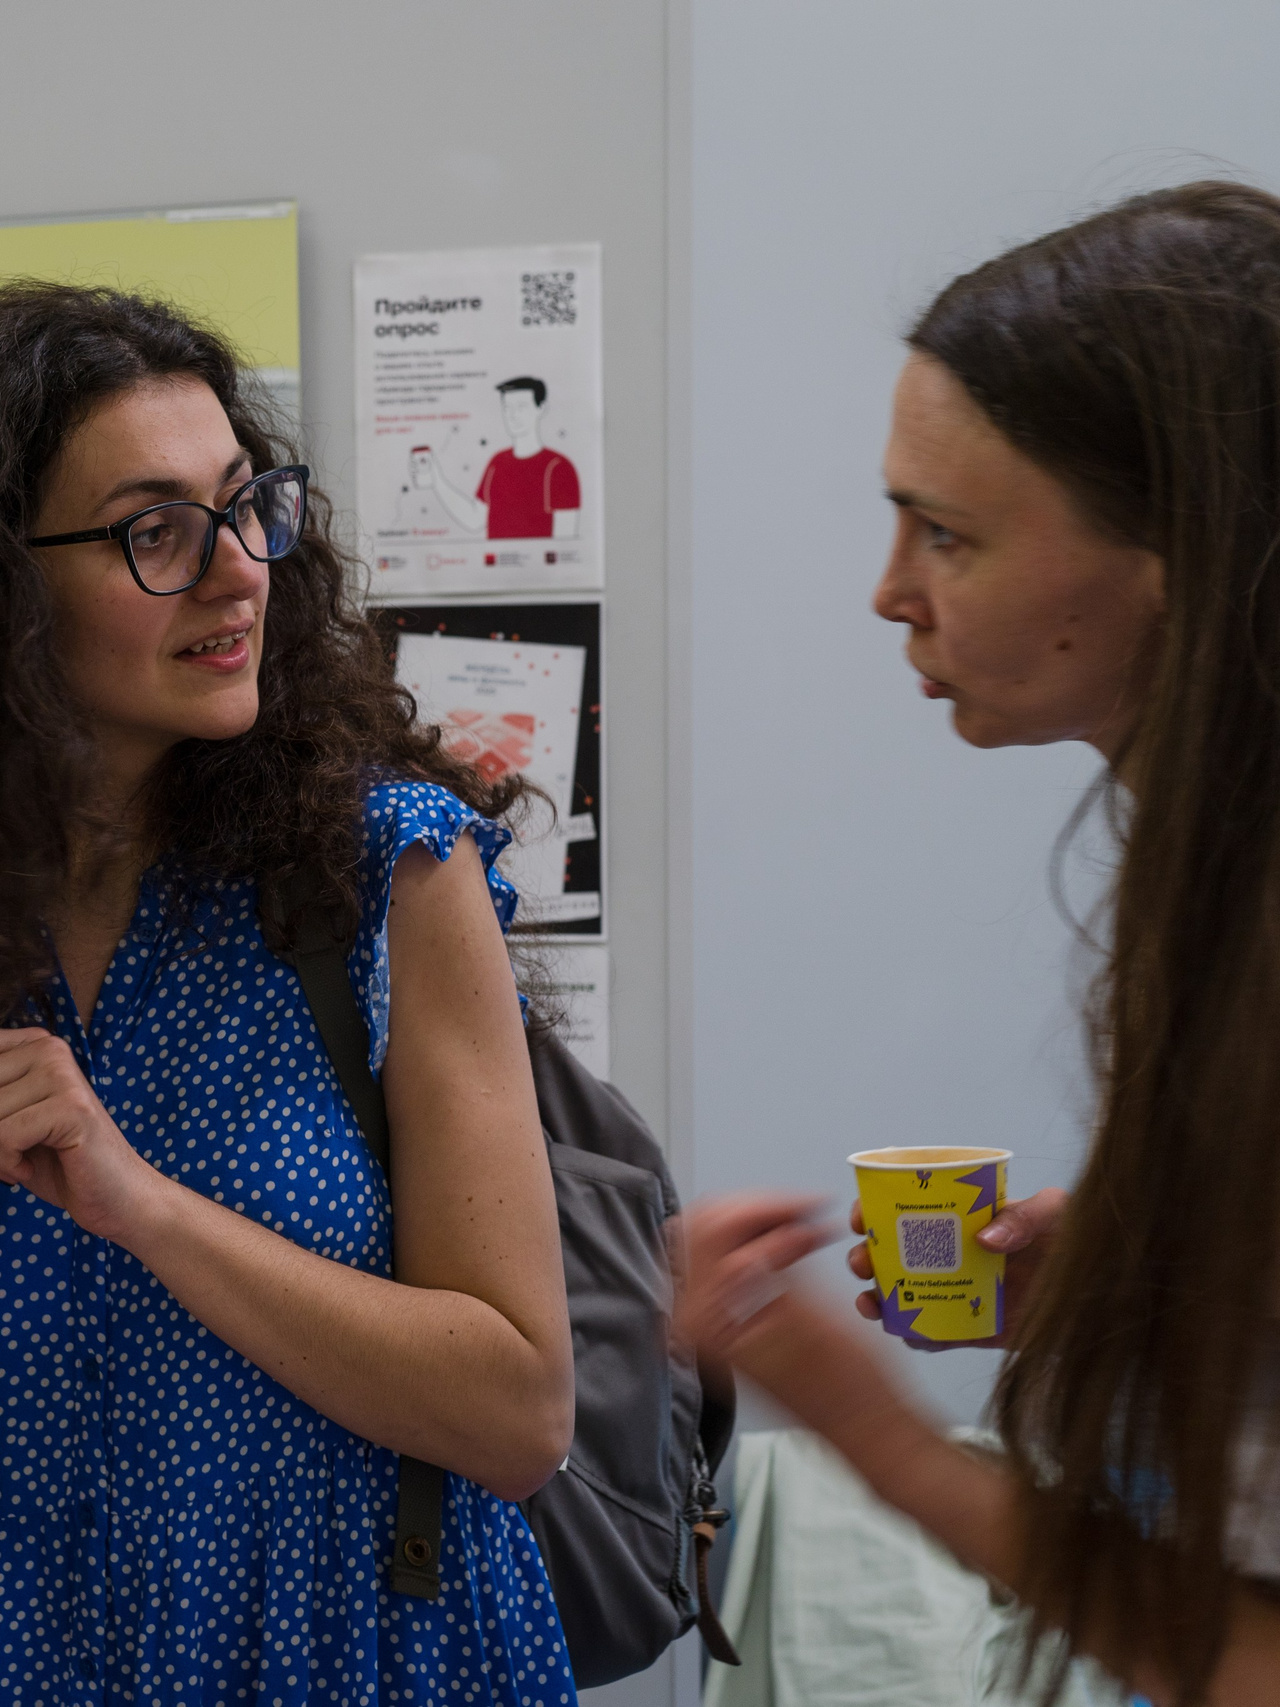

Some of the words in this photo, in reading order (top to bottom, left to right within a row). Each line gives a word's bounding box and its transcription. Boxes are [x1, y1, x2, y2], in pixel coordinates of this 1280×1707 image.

[374, 295, 483, 317] Пройдите
[374, 322, 440, 341] опрос
[895, 1203, 943, 1212] Приложение
